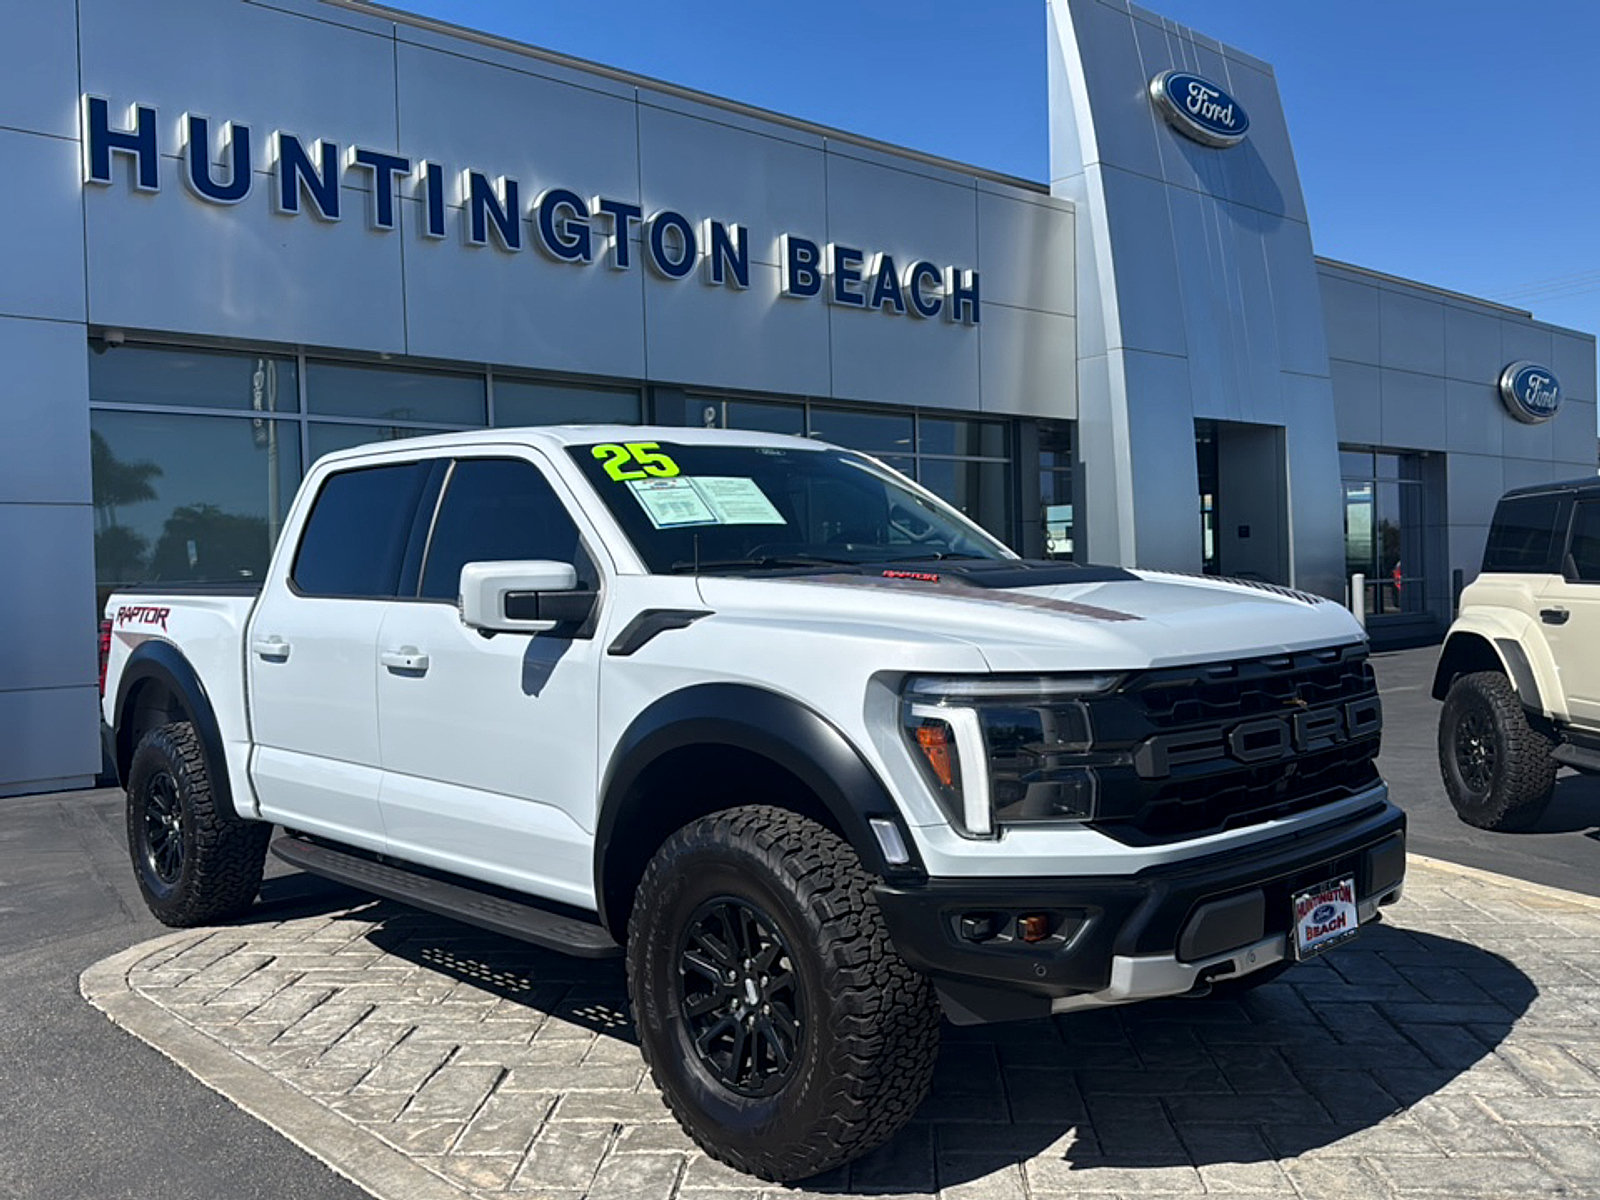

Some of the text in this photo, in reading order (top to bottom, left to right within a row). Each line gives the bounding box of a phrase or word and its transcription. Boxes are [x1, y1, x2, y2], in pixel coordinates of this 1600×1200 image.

[1187, 82, 1235, 127] Ford
[83, 94, 980, 325] HUNTINGTON BEACH
[1526, 374, 1558, 408] Ford
[591, 441, 680, 482] 25
[116, 606, 171, 634] RAPTOR
[1135, 695, 1382, 778] FORD
[1305, 911, 1347, 941] BEACH
